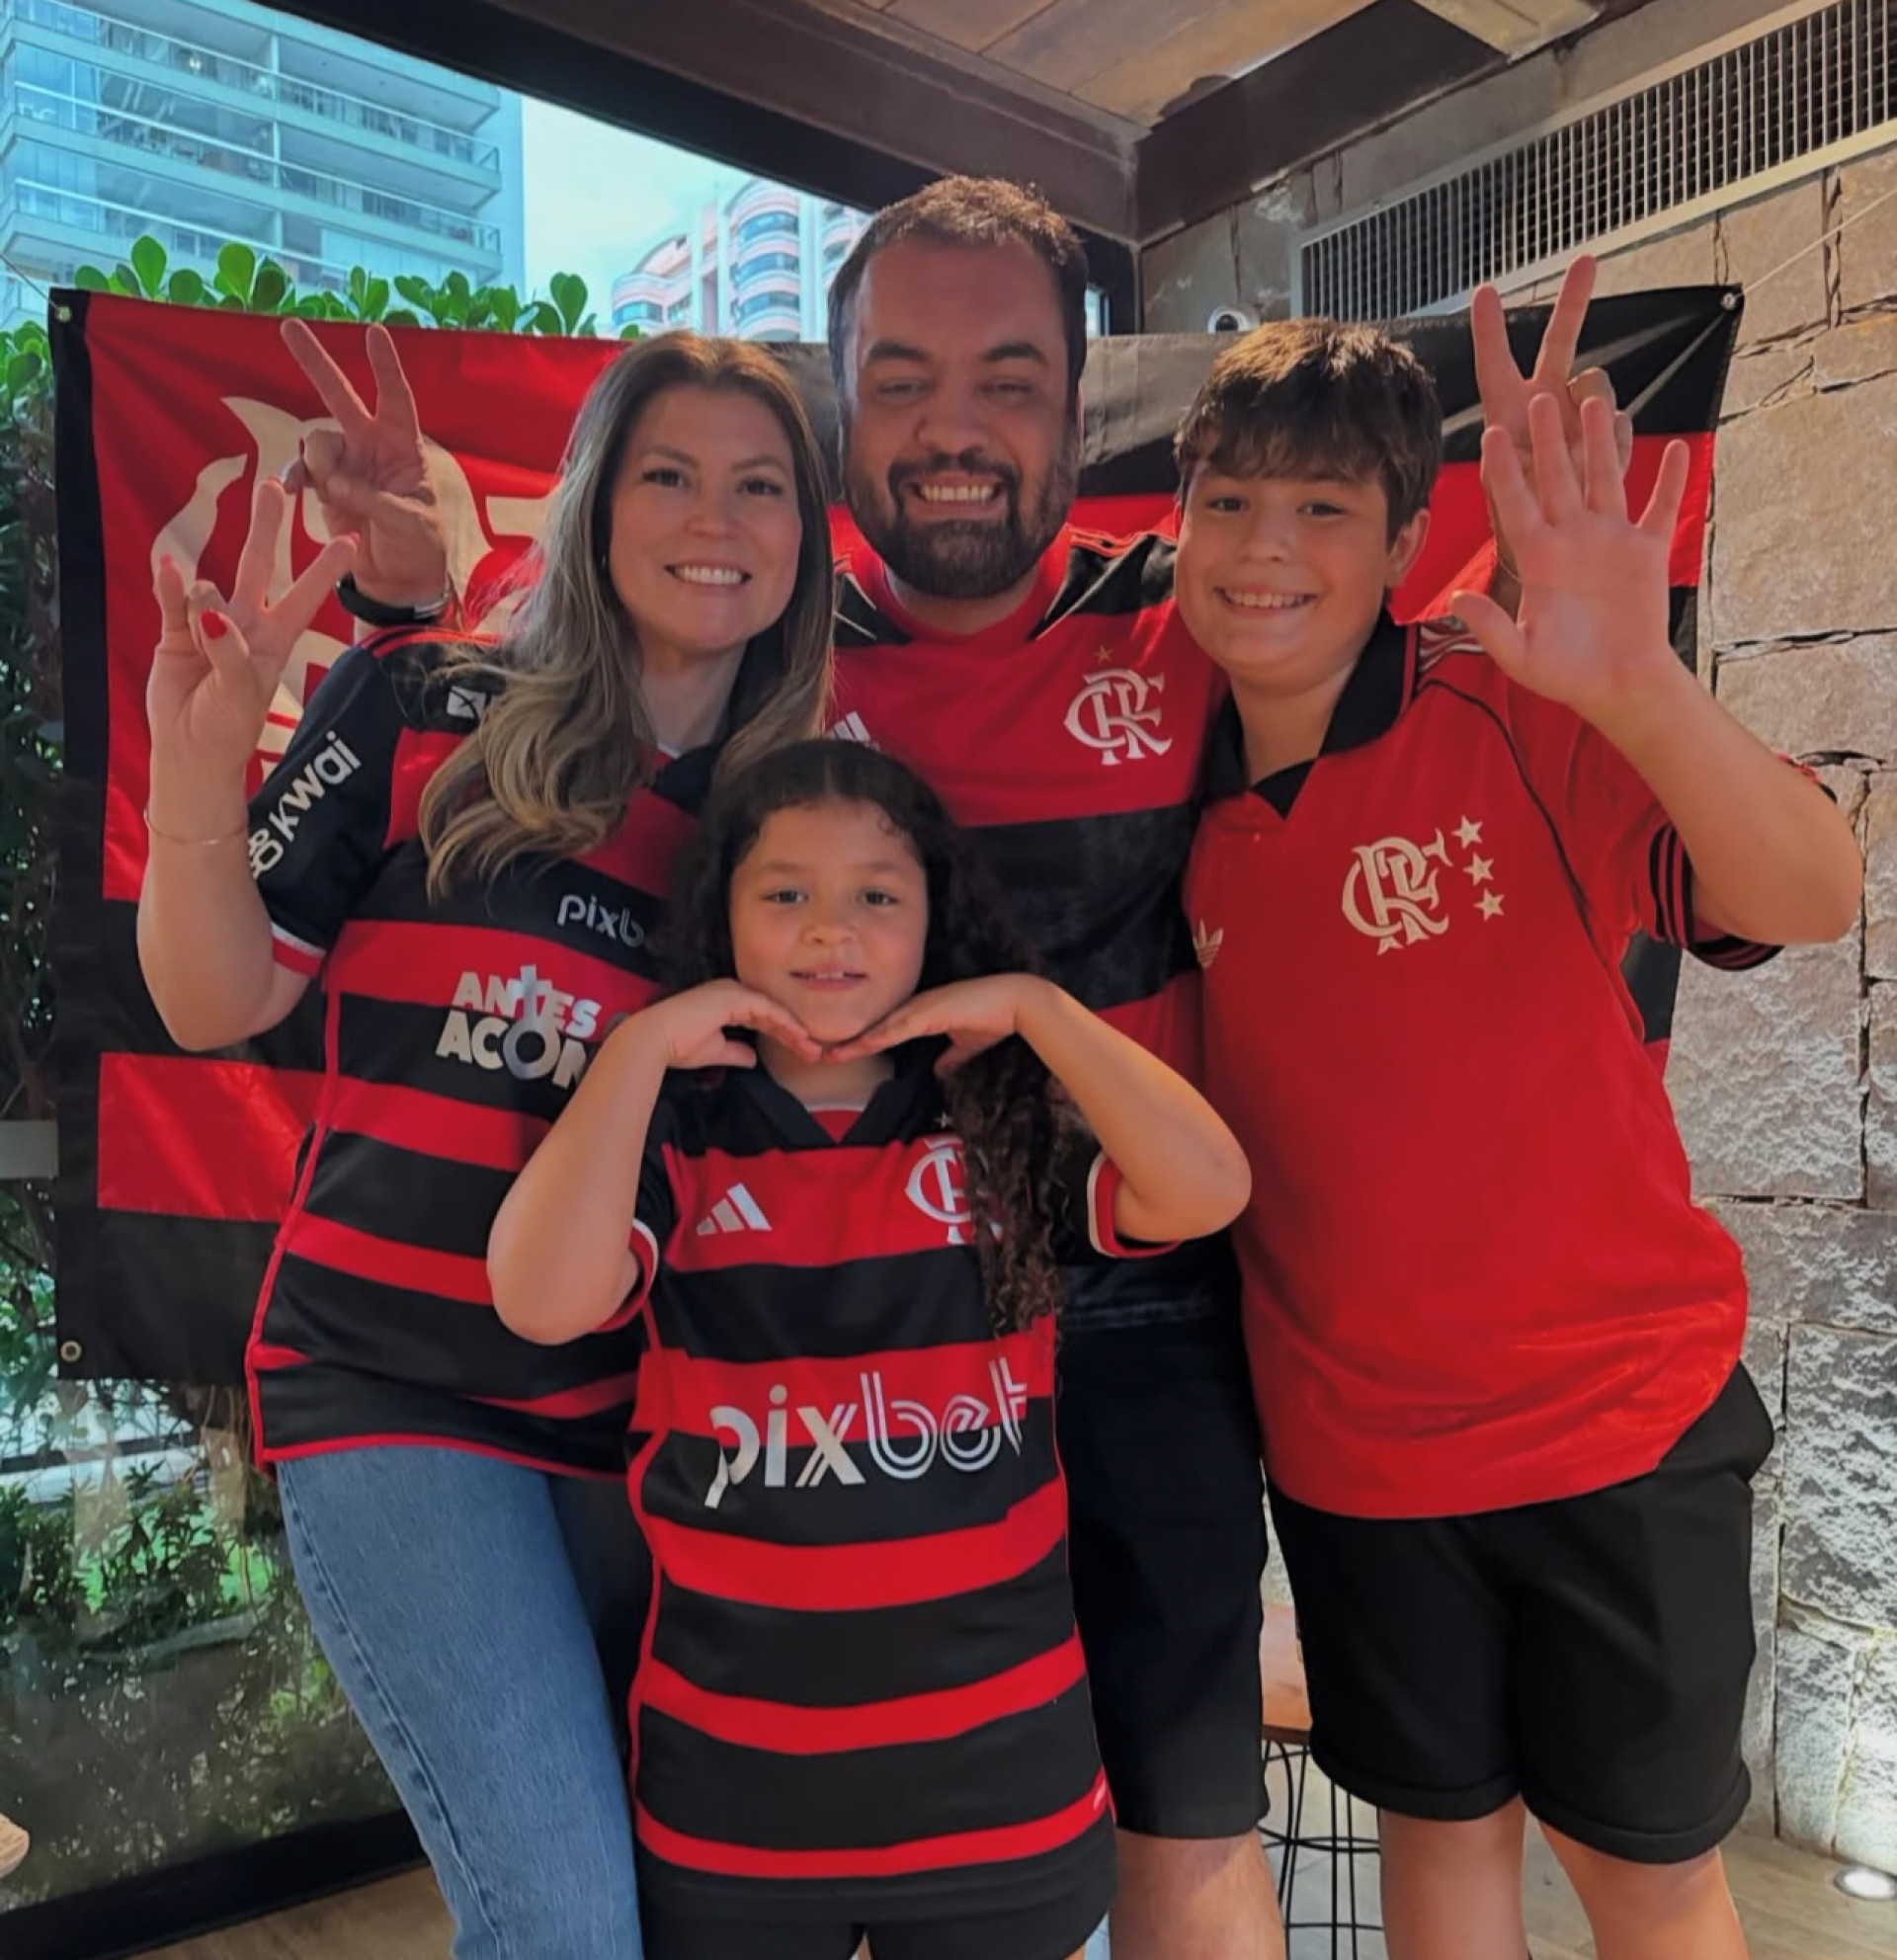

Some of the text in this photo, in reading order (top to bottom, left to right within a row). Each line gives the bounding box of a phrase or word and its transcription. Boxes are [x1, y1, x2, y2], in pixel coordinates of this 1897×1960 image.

[269, 730, 362, 843] kwai
[452, 964, 602, 1037] ANTES
[703, 1356, 1028, 1510] pixbet
